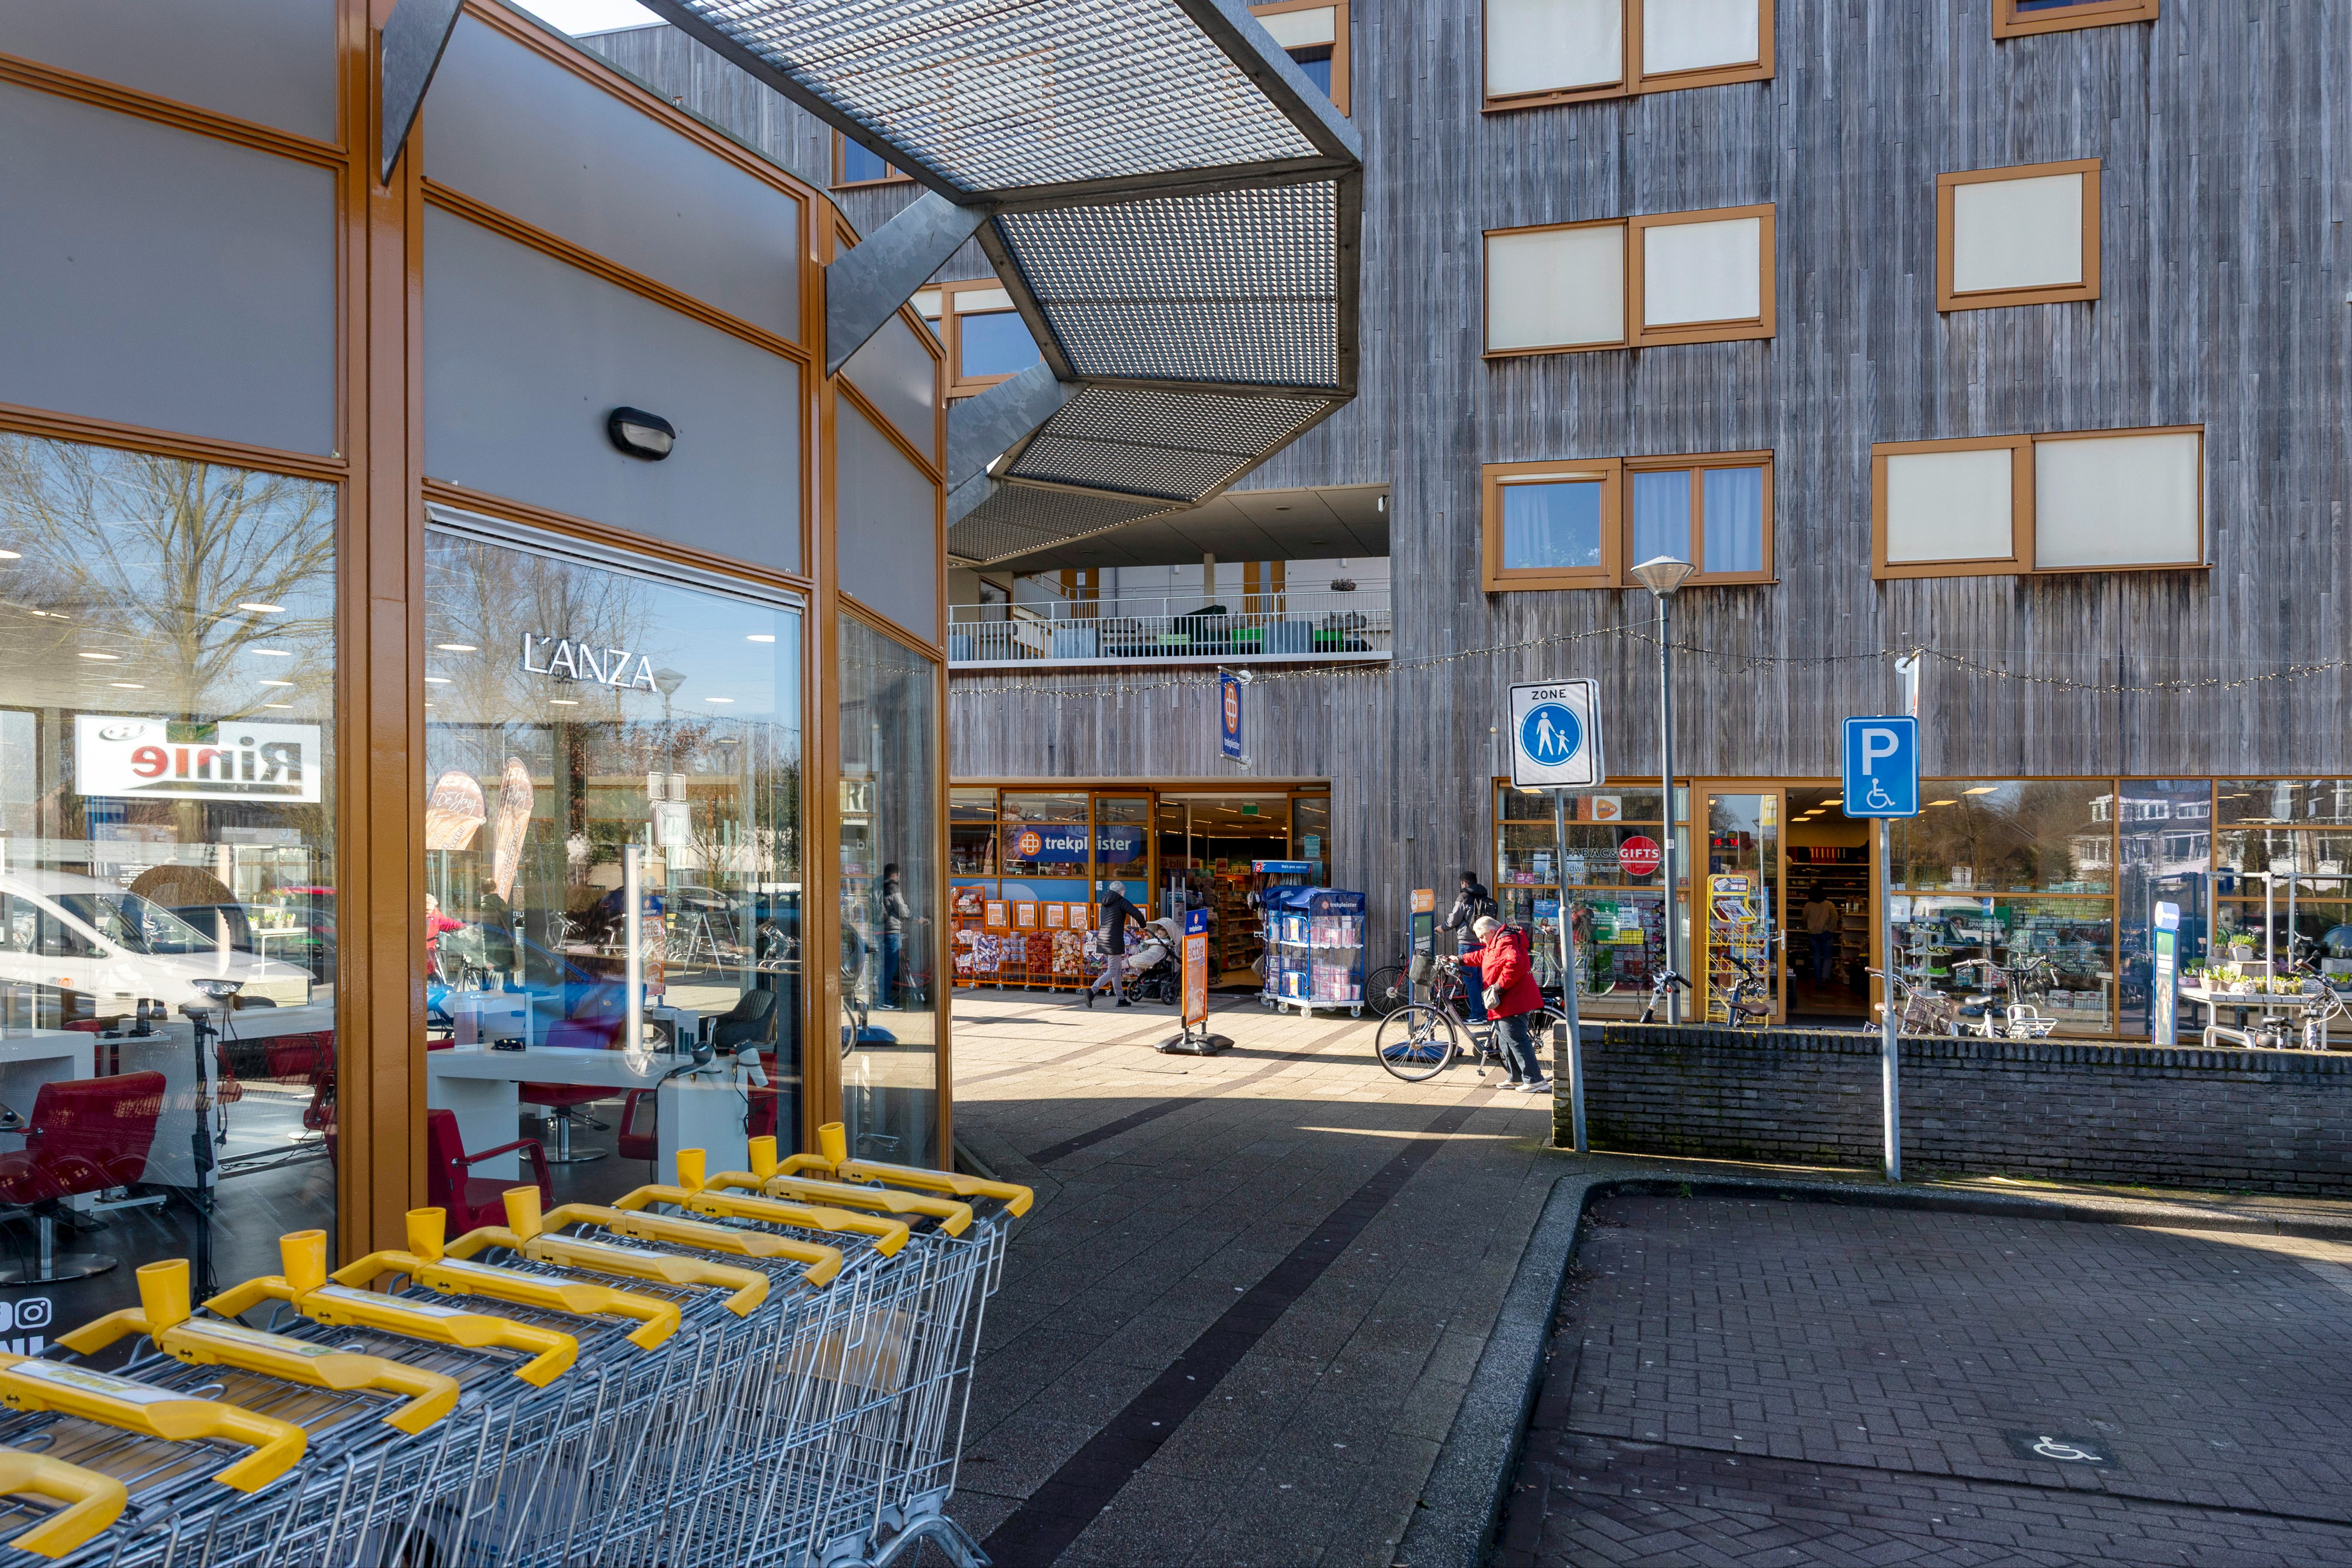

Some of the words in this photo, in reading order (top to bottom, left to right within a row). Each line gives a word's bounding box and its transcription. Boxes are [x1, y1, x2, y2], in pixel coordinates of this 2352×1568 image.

[524, 632, 658, 692] L'ANZA
[1531, 689, 1567, 700] ZONE
[1862, 728, 1899, 775] P
[1045, 836, 1131, 853] trekplister
[1620, 848, 1659, 858] GIFTS
[1188, 941, 1204, 959] actie
